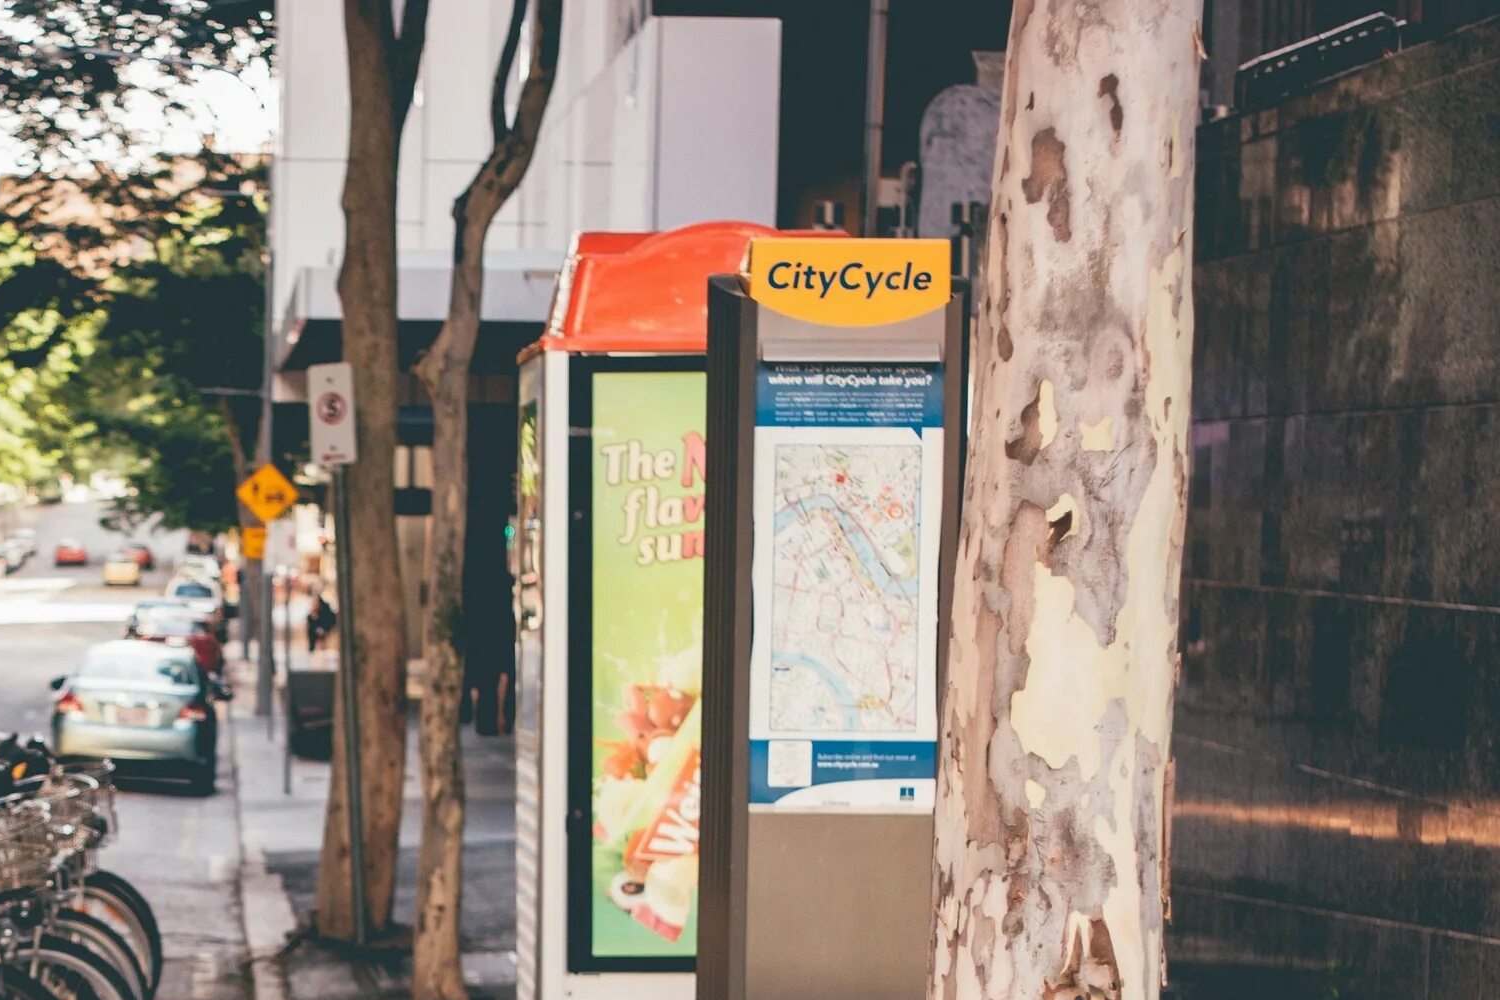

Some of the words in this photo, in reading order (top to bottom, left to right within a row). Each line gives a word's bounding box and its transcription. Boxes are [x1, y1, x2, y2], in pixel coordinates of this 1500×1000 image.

[767, 261, 933, 299] CityCycle
[768, 374, 803, 385] where
[804, 374, 824, 385] will
[825, 374, 877, 388] CityCycle
[878, 374, 903, 385] take
[904, 374, 933, 388] you?
[600, 439, 676, 486] The
